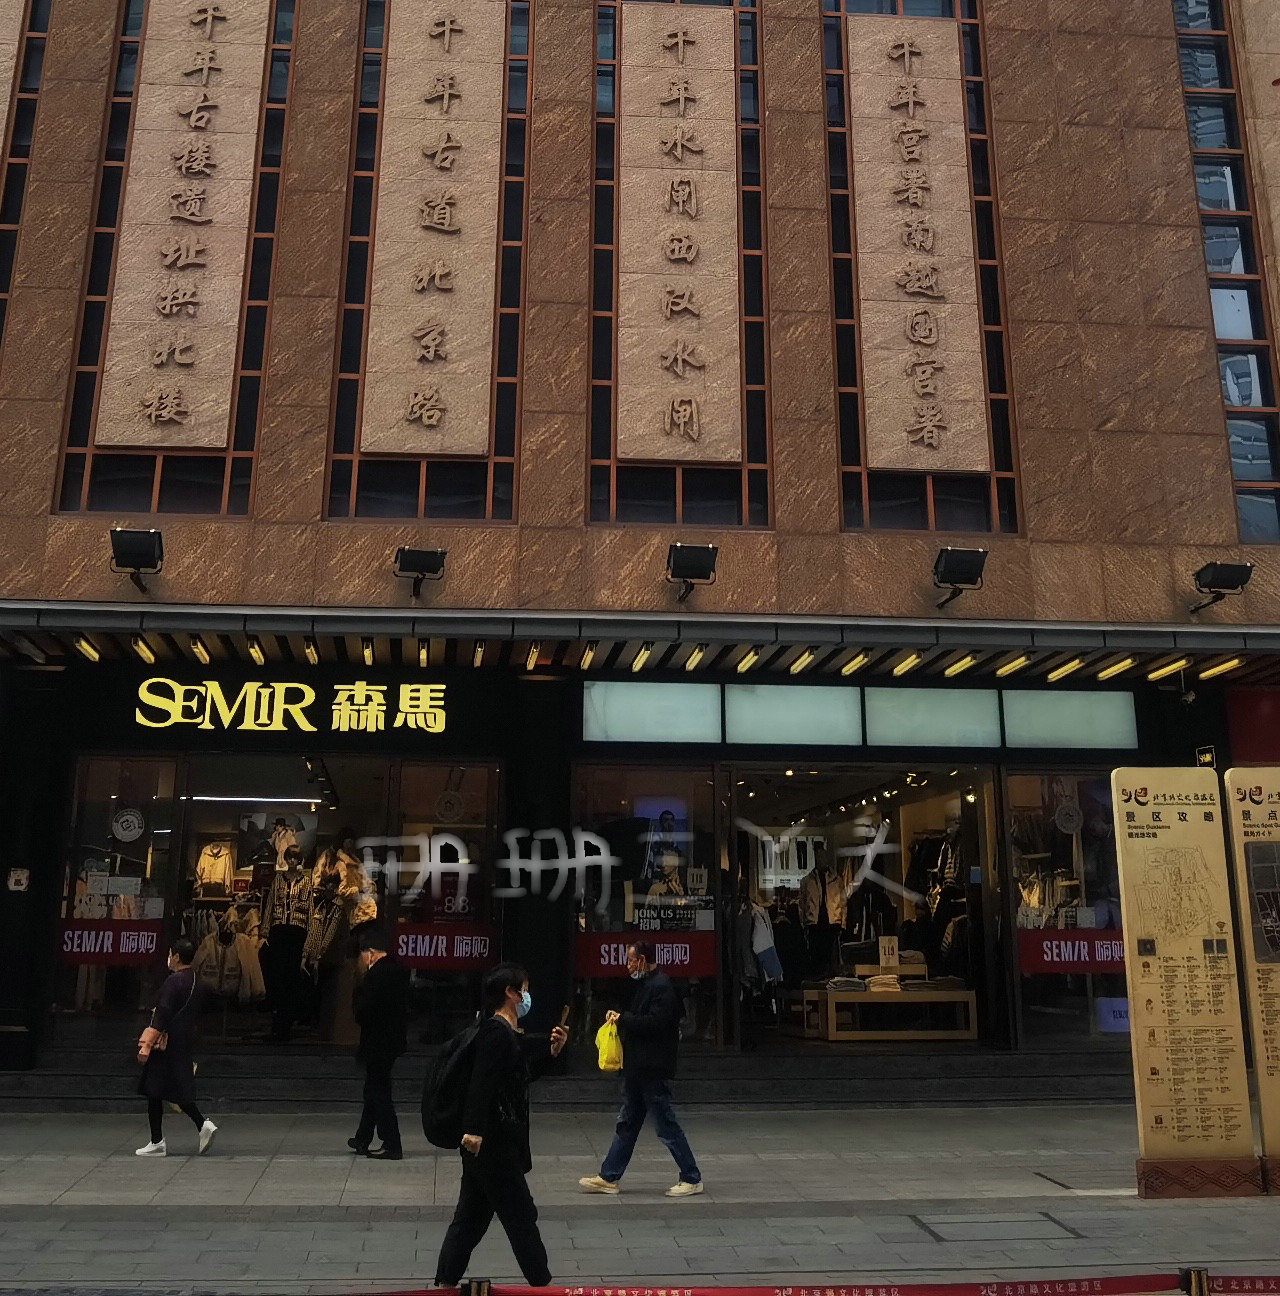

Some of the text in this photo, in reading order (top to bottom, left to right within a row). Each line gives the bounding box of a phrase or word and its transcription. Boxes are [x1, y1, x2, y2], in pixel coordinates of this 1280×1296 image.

[144, 6, 226, 425] 千年古楼遗址拱北楼
[404, 16, 464, 429] 千年古道北京路
[661, 29, 706, 442] 千年水闸西汉水闸
[135, 677, 446, 734] SEMIR 森馬
[634, 908, 658, 924] JOIN
[661, 909, 674, 918] US
[120, 931, 157, 954] 嗨购
[453, 935, 490, 958] 嗨购
[655, 943, 690, 965] 嗨购
